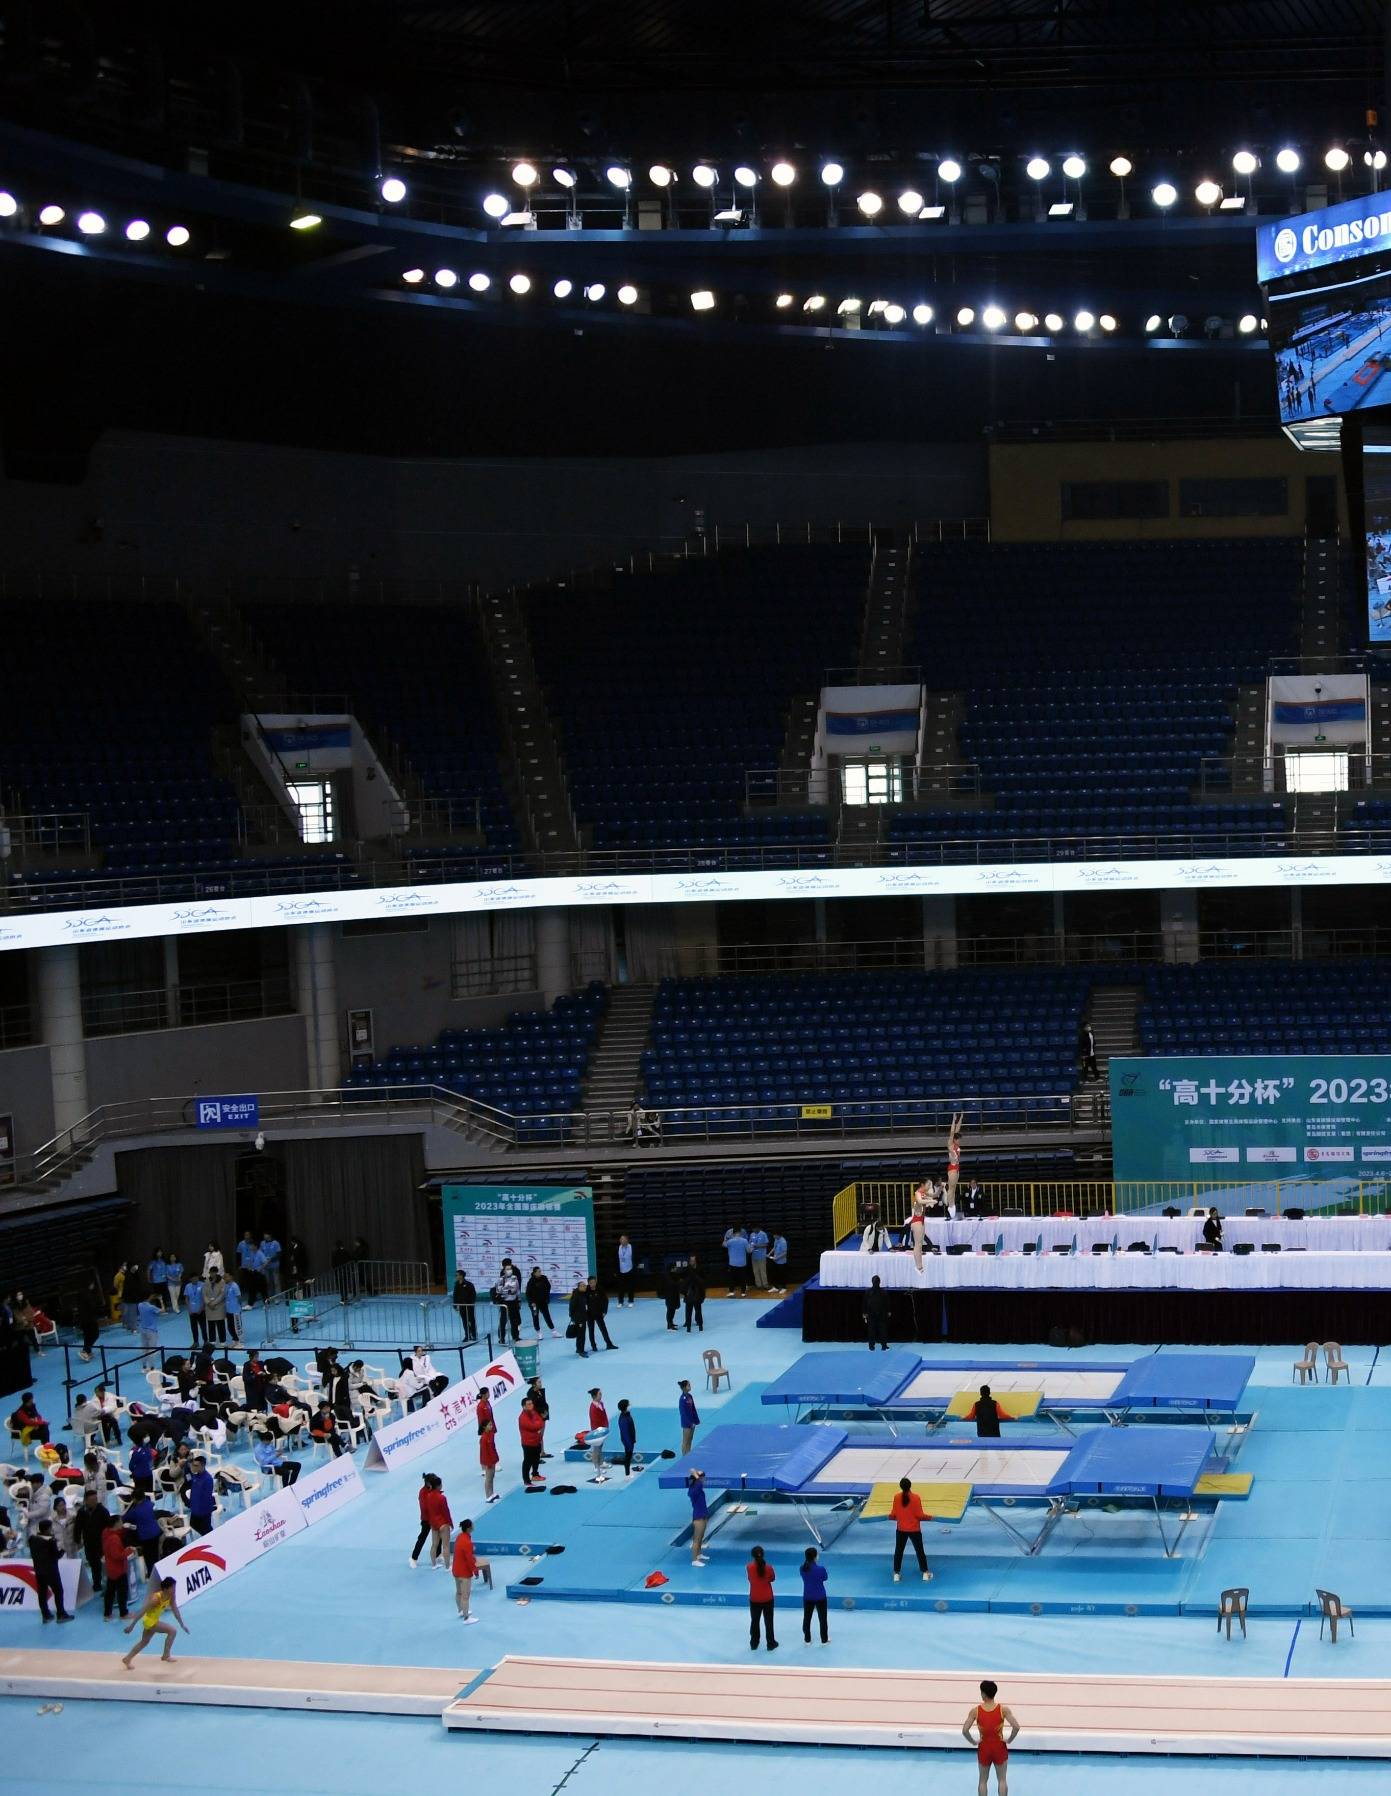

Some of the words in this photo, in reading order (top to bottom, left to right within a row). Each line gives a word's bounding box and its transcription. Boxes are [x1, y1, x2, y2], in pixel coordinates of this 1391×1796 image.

[1159, 1077, 1294, 1105] “高十分杯”
[222, 1103, 255, 1113] 安全出口
[493, 1381, 508, 1400] ANTA
[445, 1419, 458, 1431] CTS
[383, 1427, 426, 1456] springfree
[301, 1477, 344, 1508] springfree
[186, 1566, 212, 1595] ANTA
[0, 1587, 25, 1606] NTA
